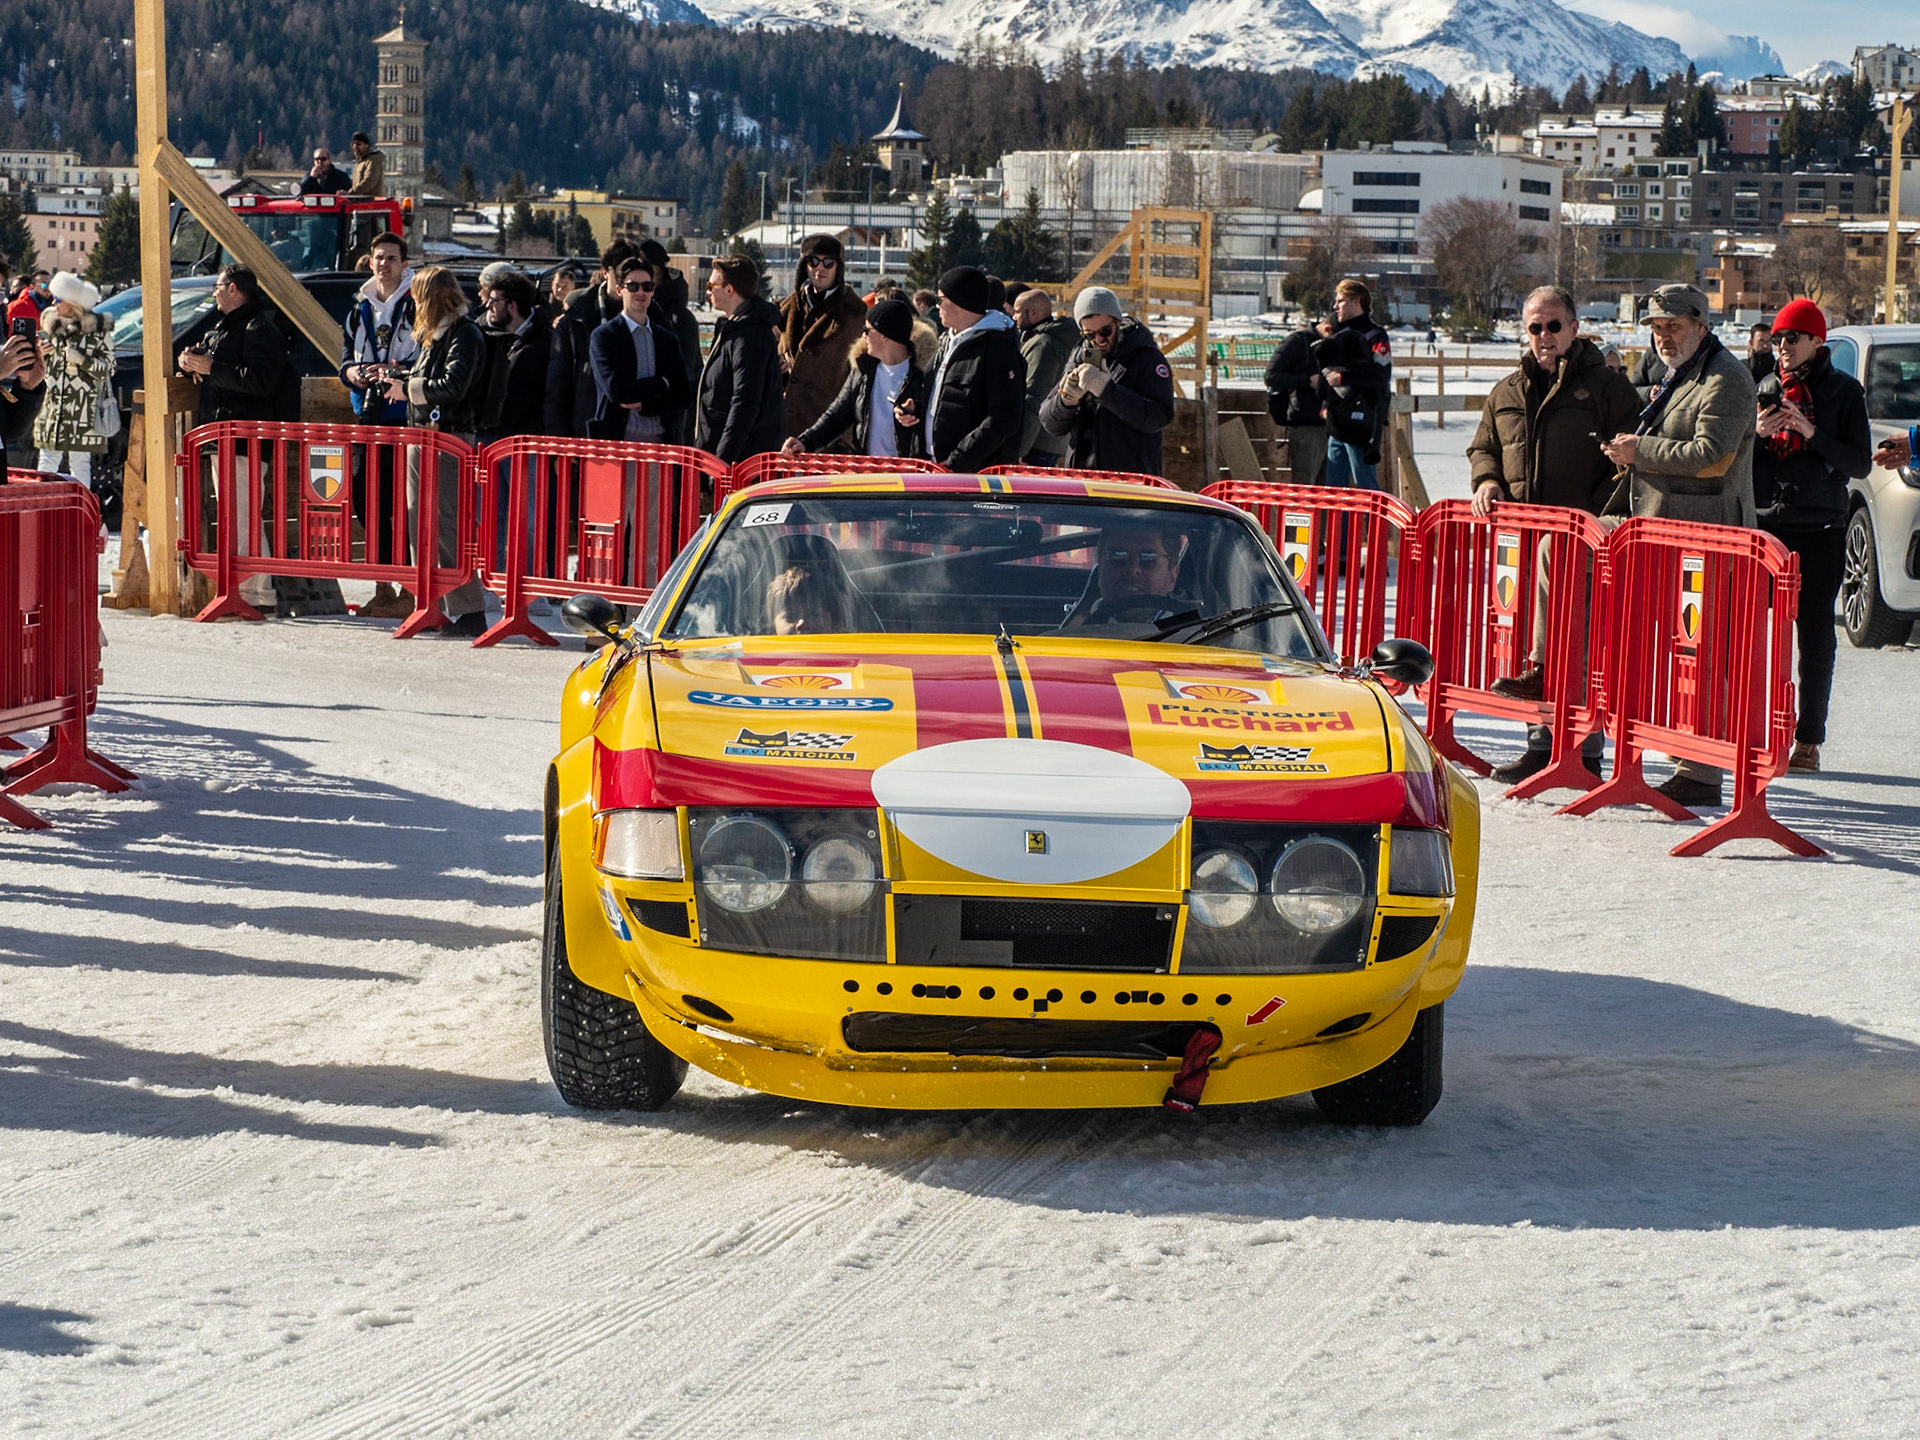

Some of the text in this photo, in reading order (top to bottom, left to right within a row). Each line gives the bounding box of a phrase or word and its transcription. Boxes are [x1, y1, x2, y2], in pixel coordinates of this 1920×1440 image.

[752, 512, 779, 524] 68
[706, 693, 875, 707] JAEGER
[1147, 703, 1355, 732] Luchard
[1161, 704, 1338, 718] PLASTIQUE
[766, 749, 852, 760] MARCHAL
[1239, 763, 1325, 772] MARCHAL
